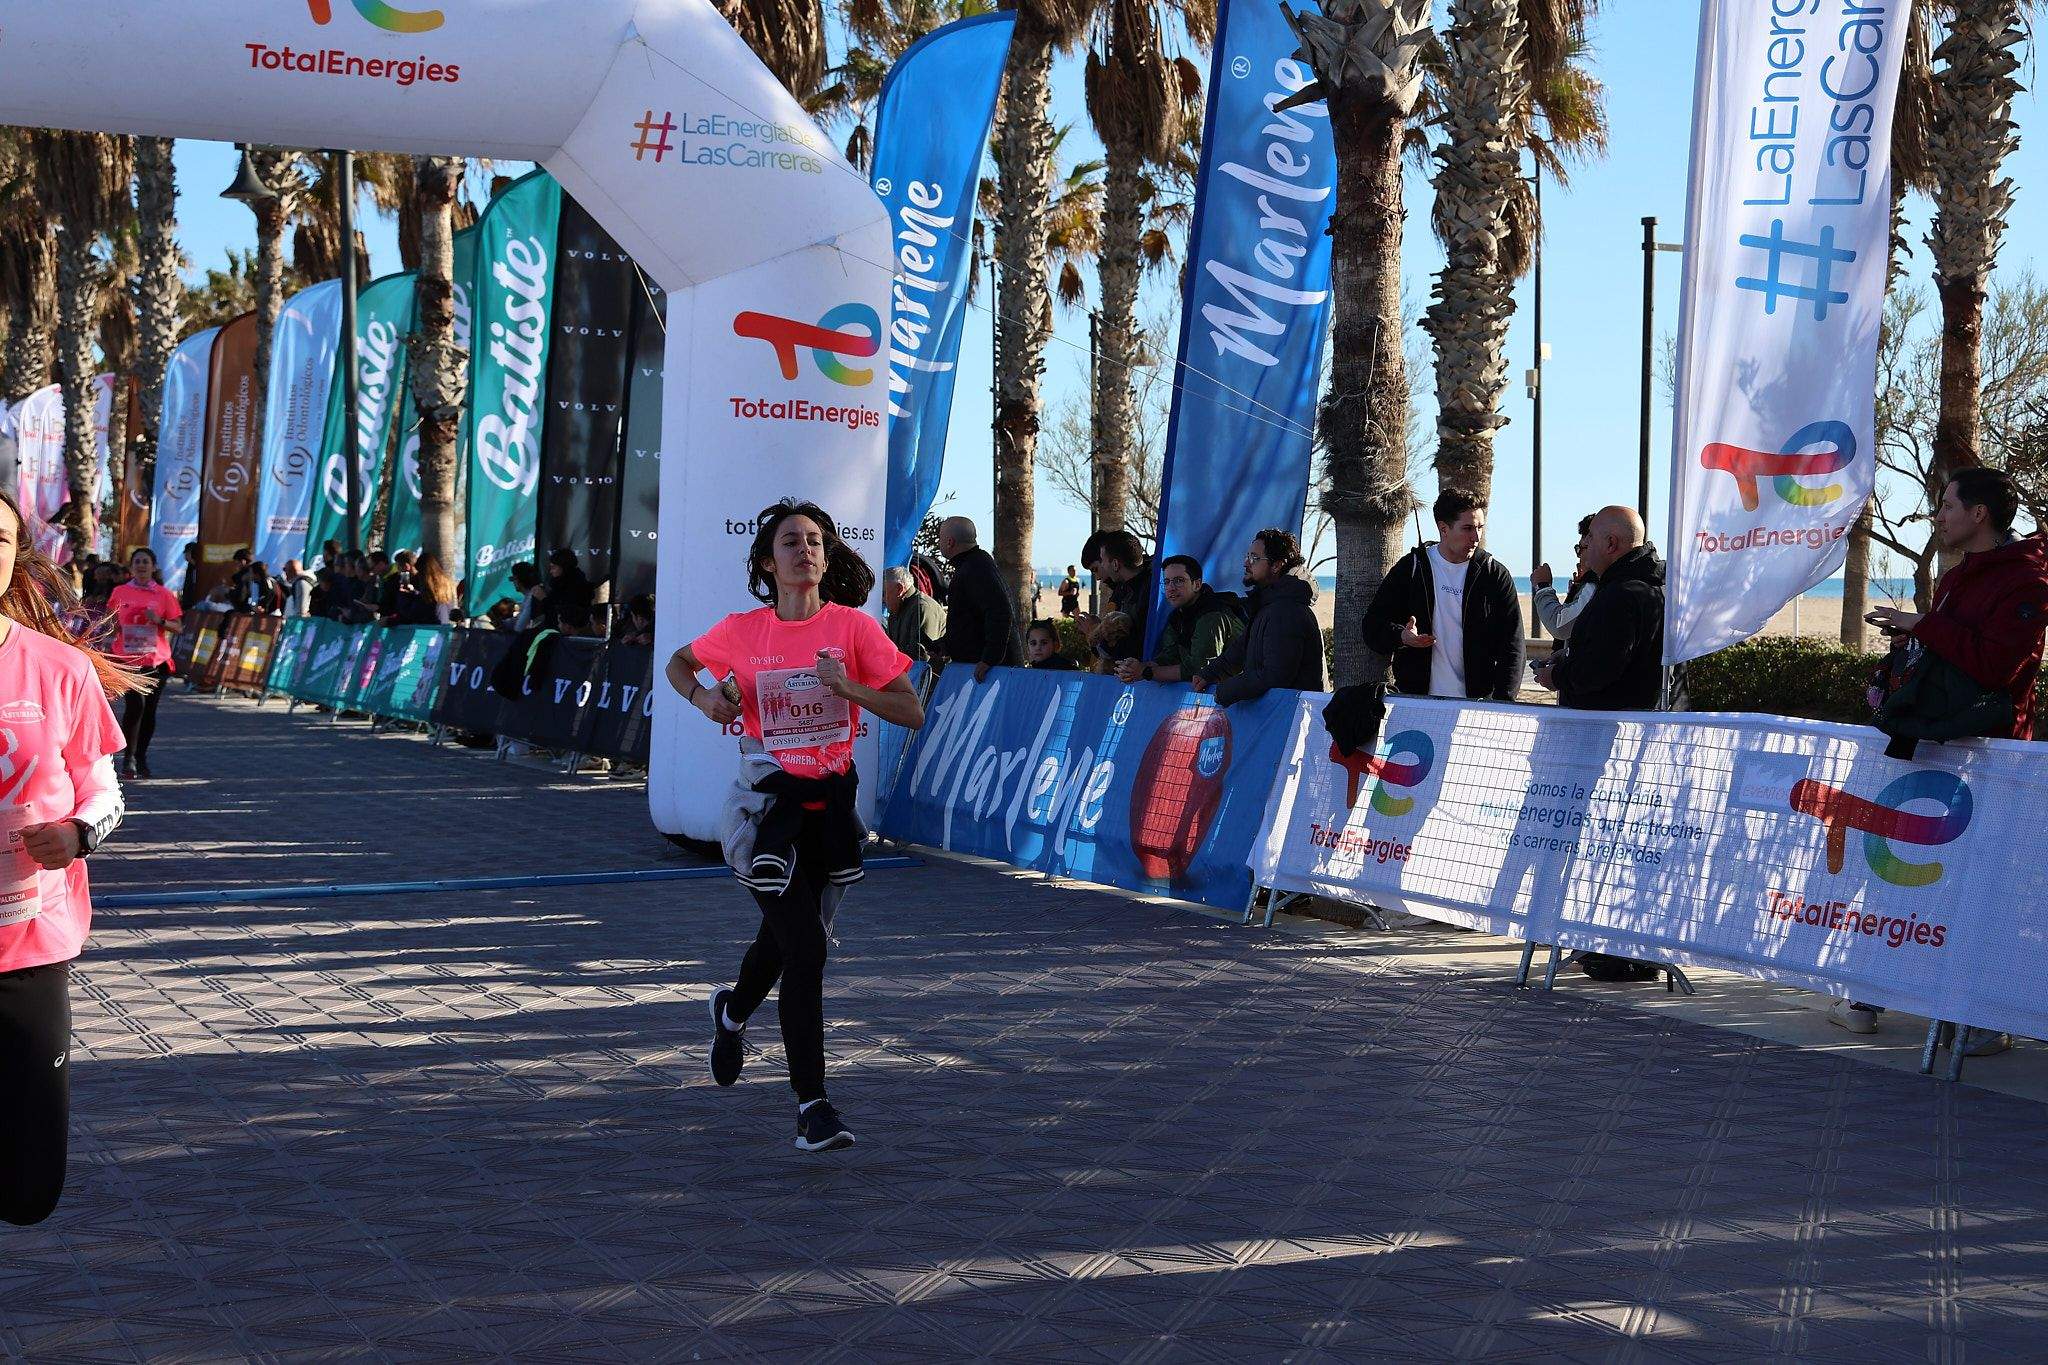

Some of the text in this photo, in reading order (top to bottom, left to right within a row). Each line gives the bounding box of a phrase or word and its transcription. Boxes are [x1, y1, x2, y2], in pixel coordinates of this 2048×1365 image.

[245, 43, 460, 86] TotalEnergies
[681, 140, 823, 175] LasCarreras
[1201, 57, 1331, 367] Marlene
[477, 236, 548, 497] Batiste
[730, 397, 880, 430] TotalEnergies
[749, 655, 785, 665] OYSHO
[790, 702, 824, 718] 016
[772, 737, 801, 746] OYSHO
[780, 752, 817, 766] CARRERA
[909, 678, 1115, 856] Marlene
[1523, 778, 1567, 799] Somos
[1571, 782, 1584, 800] la
[1598, 817, 1625, 833] que
[1629, 817, 1703, 841] patrocina
[1523, 833, 1580, 856] carreras
[1586, 840, 1663, 865] preferidas
[1768, 891, 1947, 948] TotalEnergies
